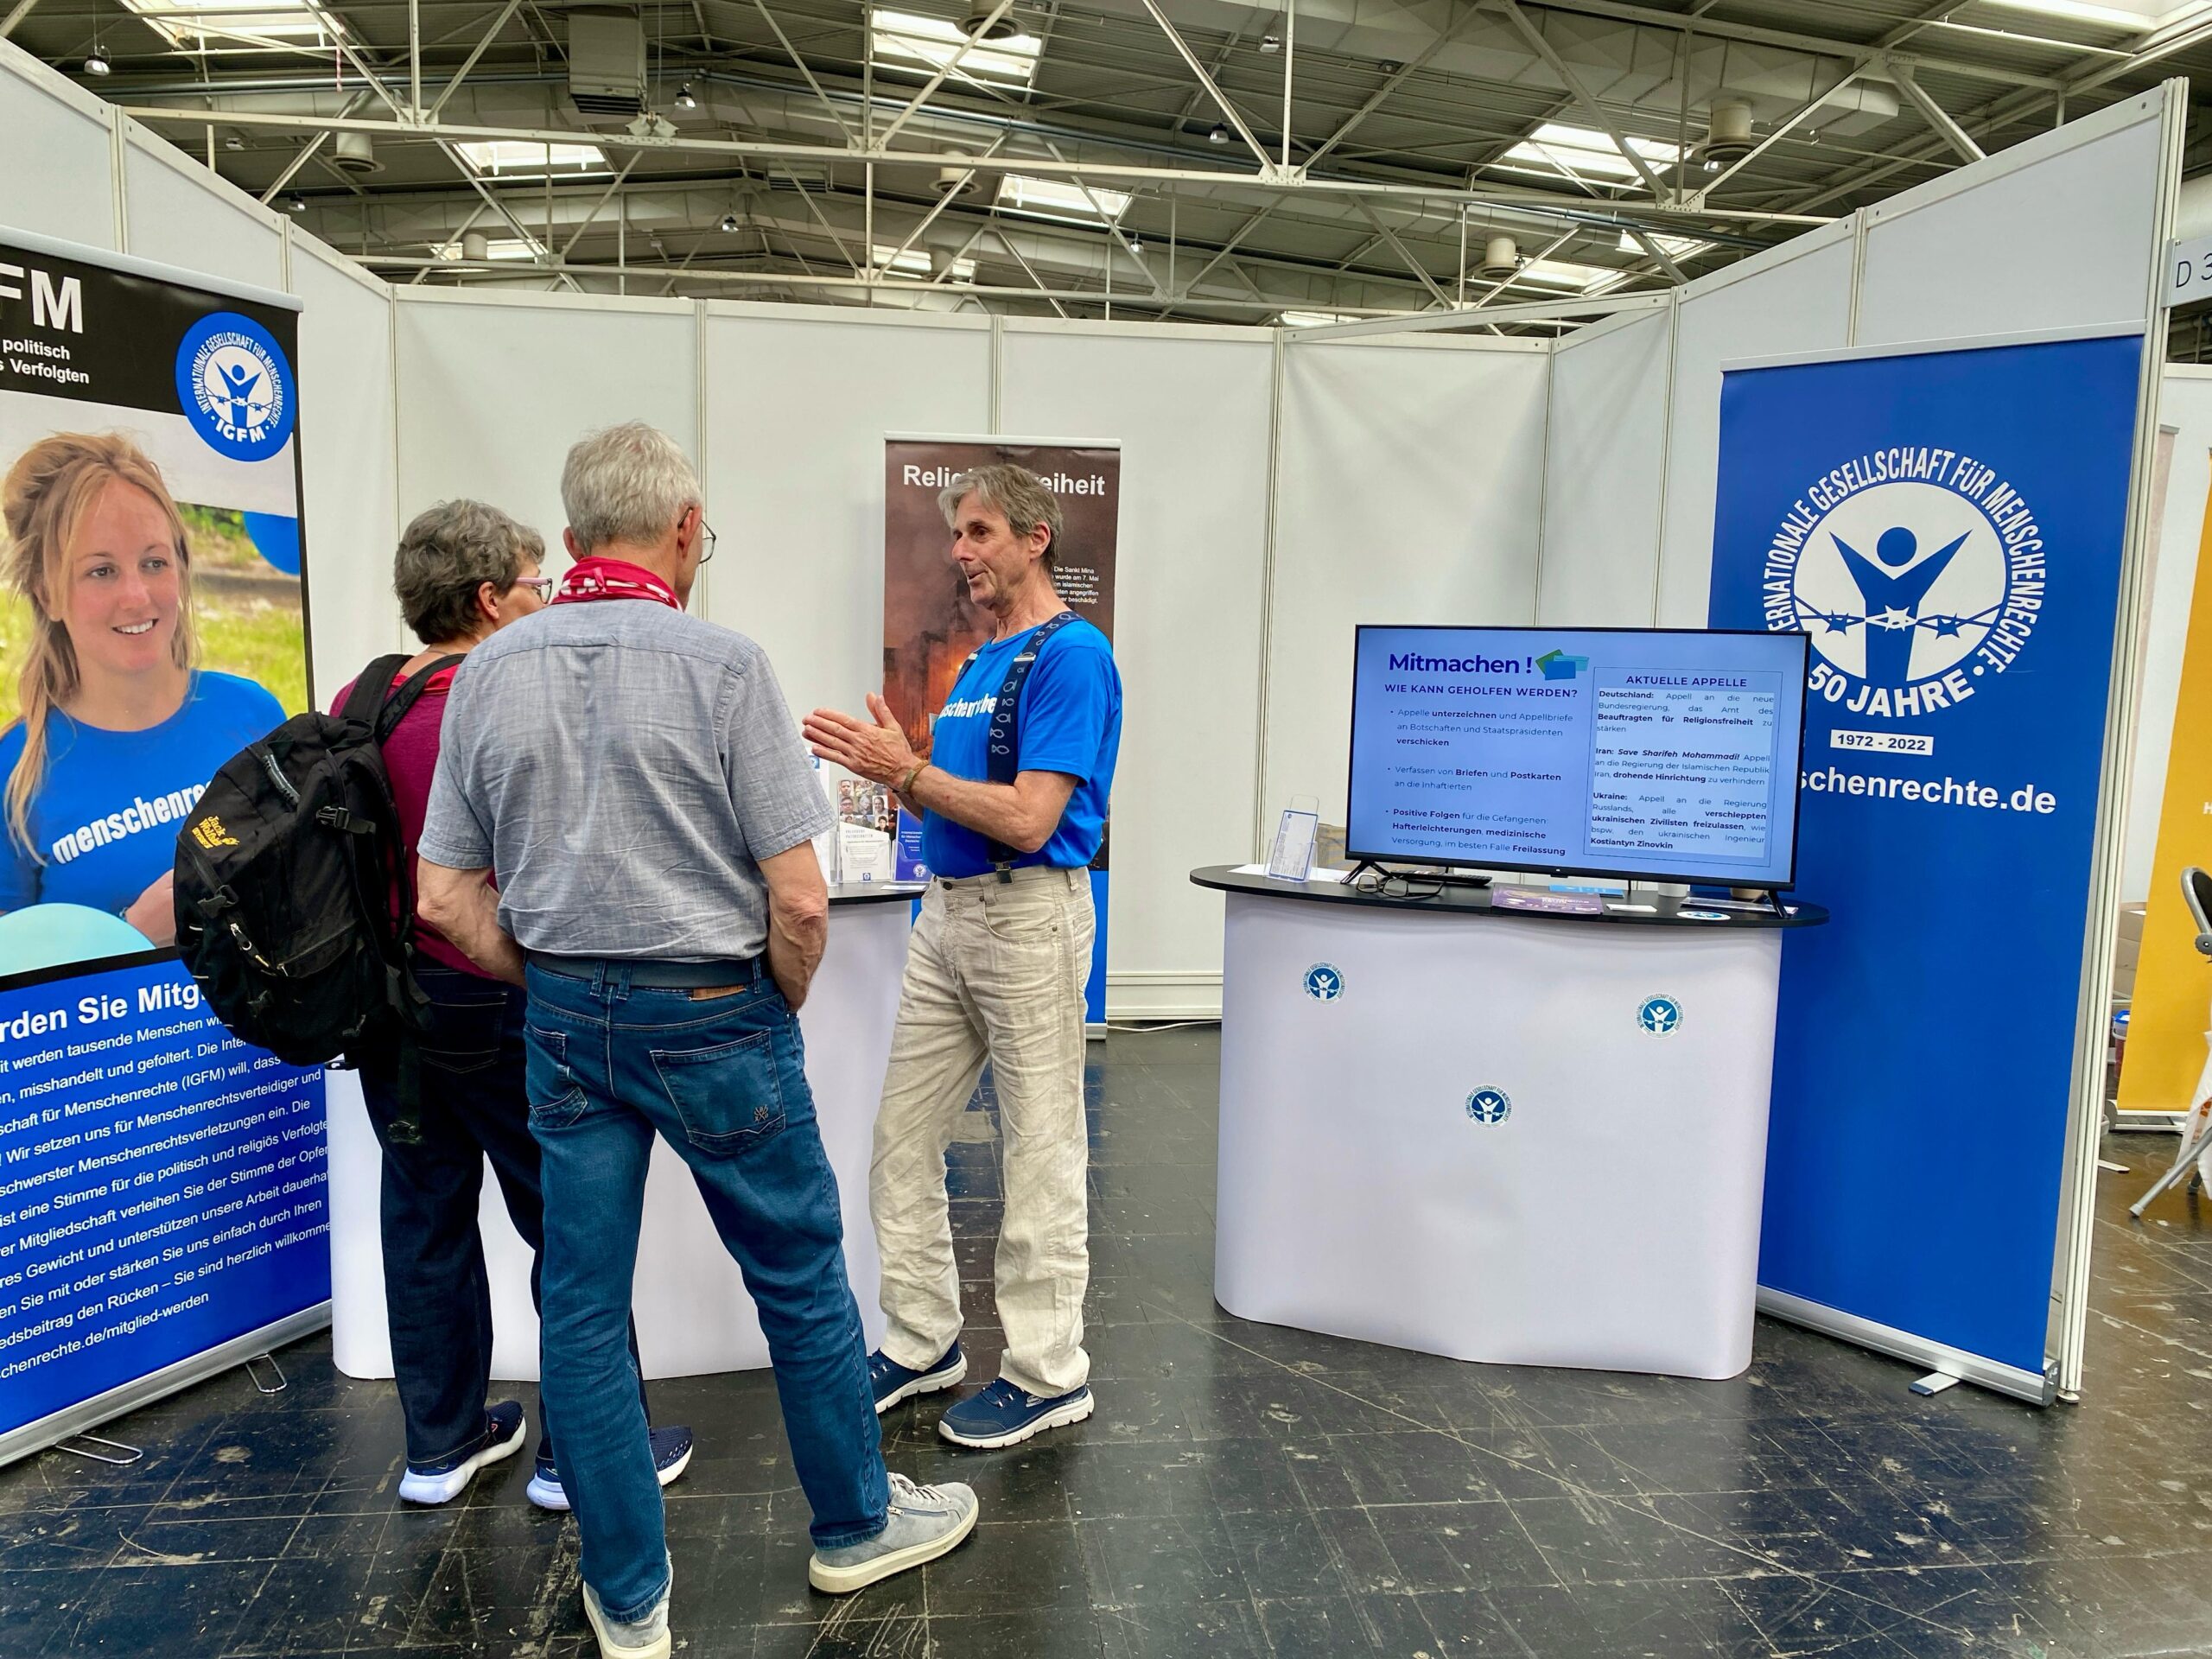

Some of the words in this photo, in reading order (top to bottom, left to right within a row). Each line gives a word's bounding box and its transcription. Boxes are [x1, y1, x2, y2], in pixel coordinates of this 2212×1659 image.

[2177, 260, 2192, 288] D
[3, 339, 71, 360] politisch
[10, 358, 90, 385] Verfolgten
[191, 343, 211, 415] INTERNATIONALE
[205, 331, 254, 353] GESELLSCHAFT
[263, 354, 283, 429] MENSCHENRECHTE
[215, 417, 266, 443] IGFM
[1763, 499, 1820, 631] ERNATIONALE
[1808, 446, 1955, 511] GESELLSCHAFT
[1980, 481, 2047, 674] MENSCHENRECHTE
[1389, 652, 1520, 674] Mitmachen
[1383, 683, 1408, 693] WIE
[1410, 684, 1444, 694] KANN
[1447, 685, 1512, 696] GEHOLFEN
[1515, 687, 1579, 698] WERDEN?
[1625, 675, 1688, 686] AKTUELLE
[1691, 677, 1748, 688] APPELLE
[1808, 662, 1847, 702] 50
[1846, 668, 1975, 718] JAHRE
[1598, 690, 1655, 699] Deutschland:
[1397, 709, 1430, 717] Appelle
[1431, 709, 1497, 720] unterzeichnen
[1498, 712, 1517, 721] und
[1518, 712, 1573, 722] Appellbriefe
[1597, 713, 1653, 723] Beauftragten
[1661, 715, 1675, 723] für
[1682, 715, 1754, 726] Religionsfreiheit
[1409, 722, 1462, 733] Botschaften
[1463, 725, 1482, 734] und
[1395, 737, 1450, 747] verschicken
[1594, 747, 1615, 755] Iran:
[1617, 747, 1639, 756] Save
[1641, 749, 1679, 759] Sharifeh
[1837, 734, 1874, 747] 1972
[1887, 737, 1927, 751] 2022
[1395, 766, 1435, 774] Verfassen
[1454, 768, 1489, 778] Briefen
[1510, 771, 1562, 781] Postkarten
[1406, 780, 1421, 789] die
[1612, 771, 1655, 780] drohende
[1655, 772, 1707, 785] Hinrichtung
[1592, 791, 1629, 801] Ukraine:
[1801, 766, 2056, 815] schenrechte.de
[52, 780, 212, 864] menschenre
[1392, 808, 1428, 818] Positive
[1429, 810, 1461, 821] Folgen
[1475, 812, 1491, 822] die
[1491, 814, 1547, 825] Gefangenen
[1591, 814, 1646, 824] ukrainischen
[1649, 817, 1689, 828] Zivilisten
[1704, 810, 1767, 821] verschleppten
[1485, 829, 1547, 840] medizinische
[1458, 840, 1489, 850] besten
[1489, 842, 1511, 852] Falle
[1511, 844, 1567, 857] Freilassung
[0, 1009, 67, 1043] rden
[78, 995, 128, 1024] Sie
[12, 1049, 63, 1070] werden
[67, 1033, 133, 1057] tausende
[137, 1020, 202, 1042] Menschen
[20, 1068, 104, 1099] misshandelt
[107, 1060, 133, 1077] und
[137, 1048, 193, 1073] gefoltert.
[197, 1043, 218, 1057] Die
[41, 1109, 60, 1122] für
[65, 1081, 178, 1117] Menschenrechte
[181, 1067, 225, 1090] (IGFM)
[228, 1061, 250, 1076] will,
[254, 1056, 281, 1070] dass
[5, 1147, 30, 1163] Wir
[34, 1135, 80, 1155] setzen
[85, 1127, 111, 1141] uns
[114, 1120, 133, 1134] für
[137, 1077, 299, 1128] Menschenrechtsverteidiger
[302, 1068, 321, 1084] und
[0, 1165, 74, 1197] schwerster
[78, 1113, 264, 1173] Menschenrechtsverletzungen
[268, 1106, 289, 1119] ein.
[292, 1100, 310, 1113] Die
[19, 1203, 49, 1220] eine
[54, 1185, 107, 1209] Stimme
[111, 1179, 130, 1192] für
[134, 1172, 154, 1186] die
[158, 1154, 208, 1182] politisch
[213, 1146, 234, 1162] und
[238, 1135, 279, 1155] religiös
[282, 1120, 327, 1141] Verfolgte
[19, 1210, 117, 1251] Mitgliedschaft
[119, 1192, 180, 1218] verleihen
[183, 1185, 204, 1198] Sie
[207, 1178, 227, 1192] der
[231, 1163, 275, 1184] Stimme
[278, 1156, 296, 1169] der
[26, 1249, 84, 1278] Gewicht
[88, 1238, 114, 1258] und
[118, 1215, 198, 1248] unterstützen
[202, 1200, 243, 1221] unsere
[245, 1185, 280, 1206] Arbeit
[283, 1169, 328, 1194] dauerha
[21, 1294, 43, 1310] Sie
[48, 1283, 71, 1300] mit
[73, 1273, 105, 1292] oder
[109, 1255, 159, 1280] stärken
[162, 1247, 183, 1262] Sie
[187, 1238, 209, 1253] uns
[213, 1221, 256, 1244] einfach
[259, 1209, 290, 1228] durch
[295, 1200, 321, 1216] Ihren
[77, 1303, 103, 1319] den
[107, 1284, 158, 1309] Rücken
[175, 1270, 194, 1285] Sie
[198, 1258, 223, 1276] sind
[226, 1242, 271, 1267] herzlich
[275, 1214, 330, 1249] willkomme
[0, 1293, 209, 1379] chenrechte.de/mitglied-werden
